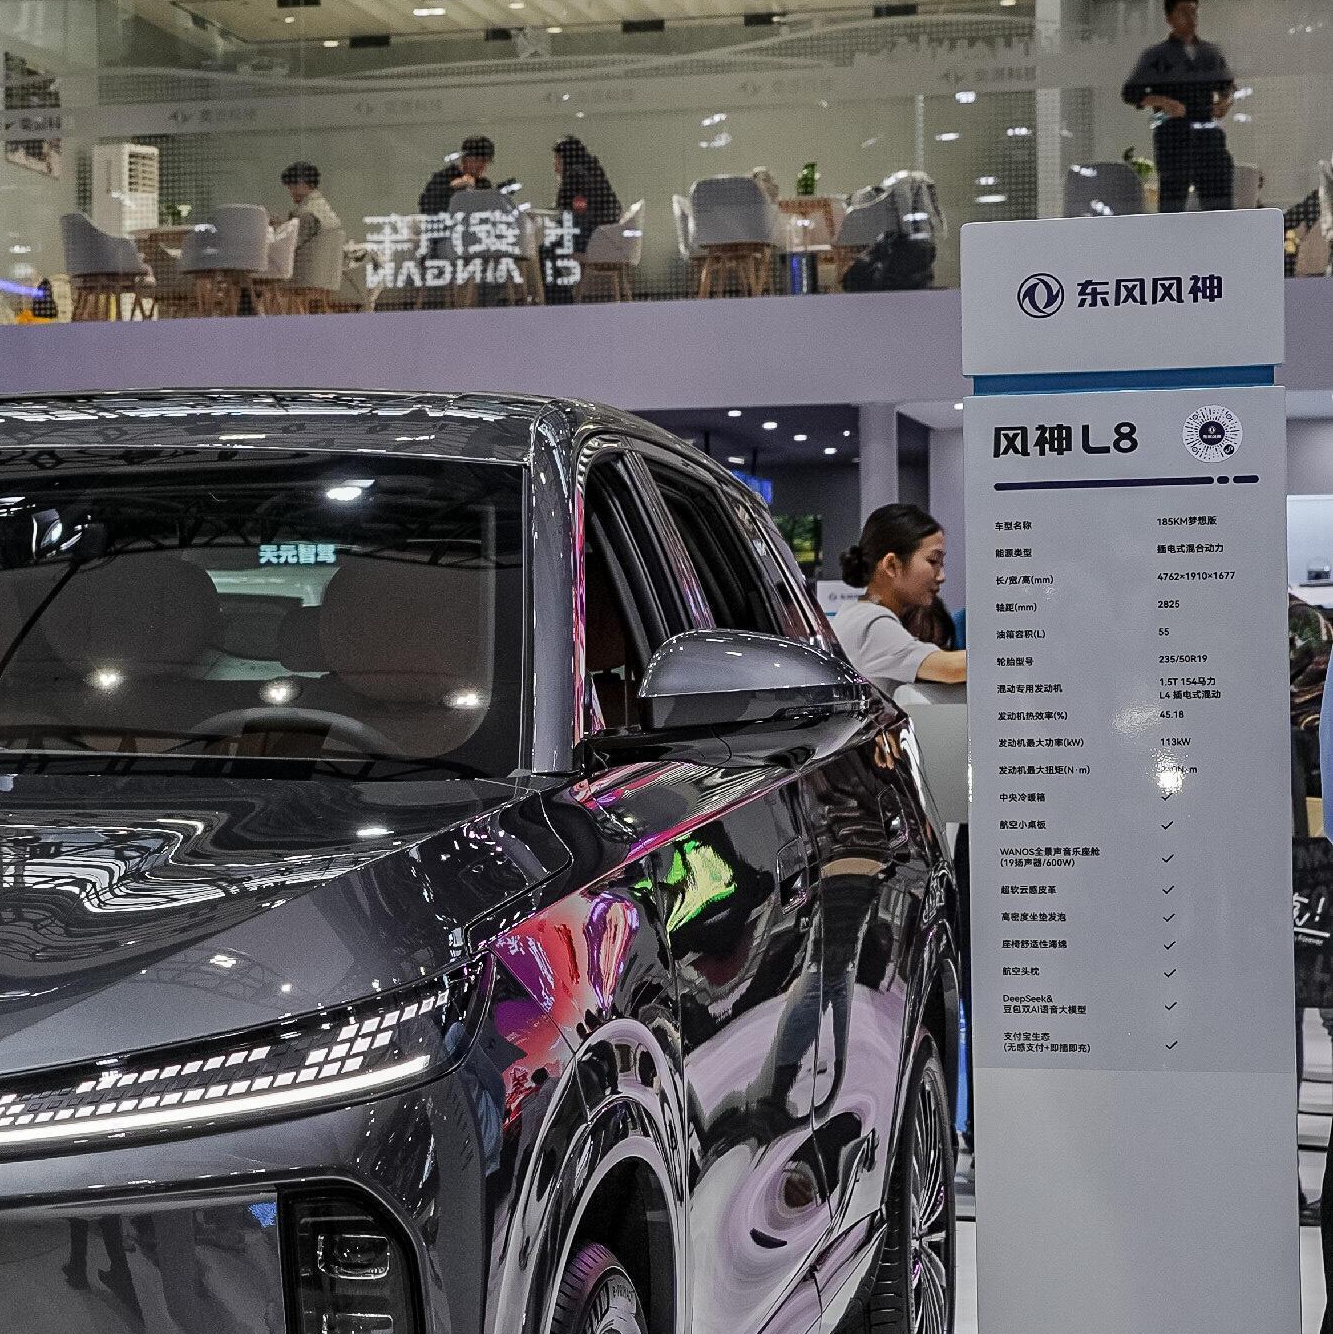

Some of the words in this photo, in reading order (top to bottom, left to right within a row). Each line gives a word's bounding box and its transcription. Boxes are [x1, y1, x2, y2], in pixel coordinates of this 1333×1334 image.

[1076, 273, 1223, 308] 东风风神
[994, 520, 1033, 532] 车型名称
[1156, 515, 1218, 526] 185KM梦想版
[995, 547, 1033, 559] 能源类型
[1156, 542, 1224, 554] 插电式混合动力
[995, 602, 1038, 613] 轴距(mm)
[1157, 599, 1180, 609] 2825
[995, 629, 1046, 640] 油箱容积(L)
[1158, 627, 1170, 637] 55
[996, 656, 1035, 667] 轮胎型号
[1157, 654, 1208, 664] 235/50R19
[1159, 677, 1179, 687] 1.5T
[1180, 676, 1216, 687] 154马力
[996, 683, 1063, 694] 混动专用发动机
[1159, 691, 1171, 700] L4
[1172, 689, 1222, 700] 插电式混动
[1159, 709, 1185, 719] 45.18
[1160, 737, 1192, 747] 113kW
[1002, 966, 1040, 976] 航空头枕
[1002, 994, 1054, 1005] DeepSeek&
[1003, 1031, 1051, 1042] 支付宝生态
